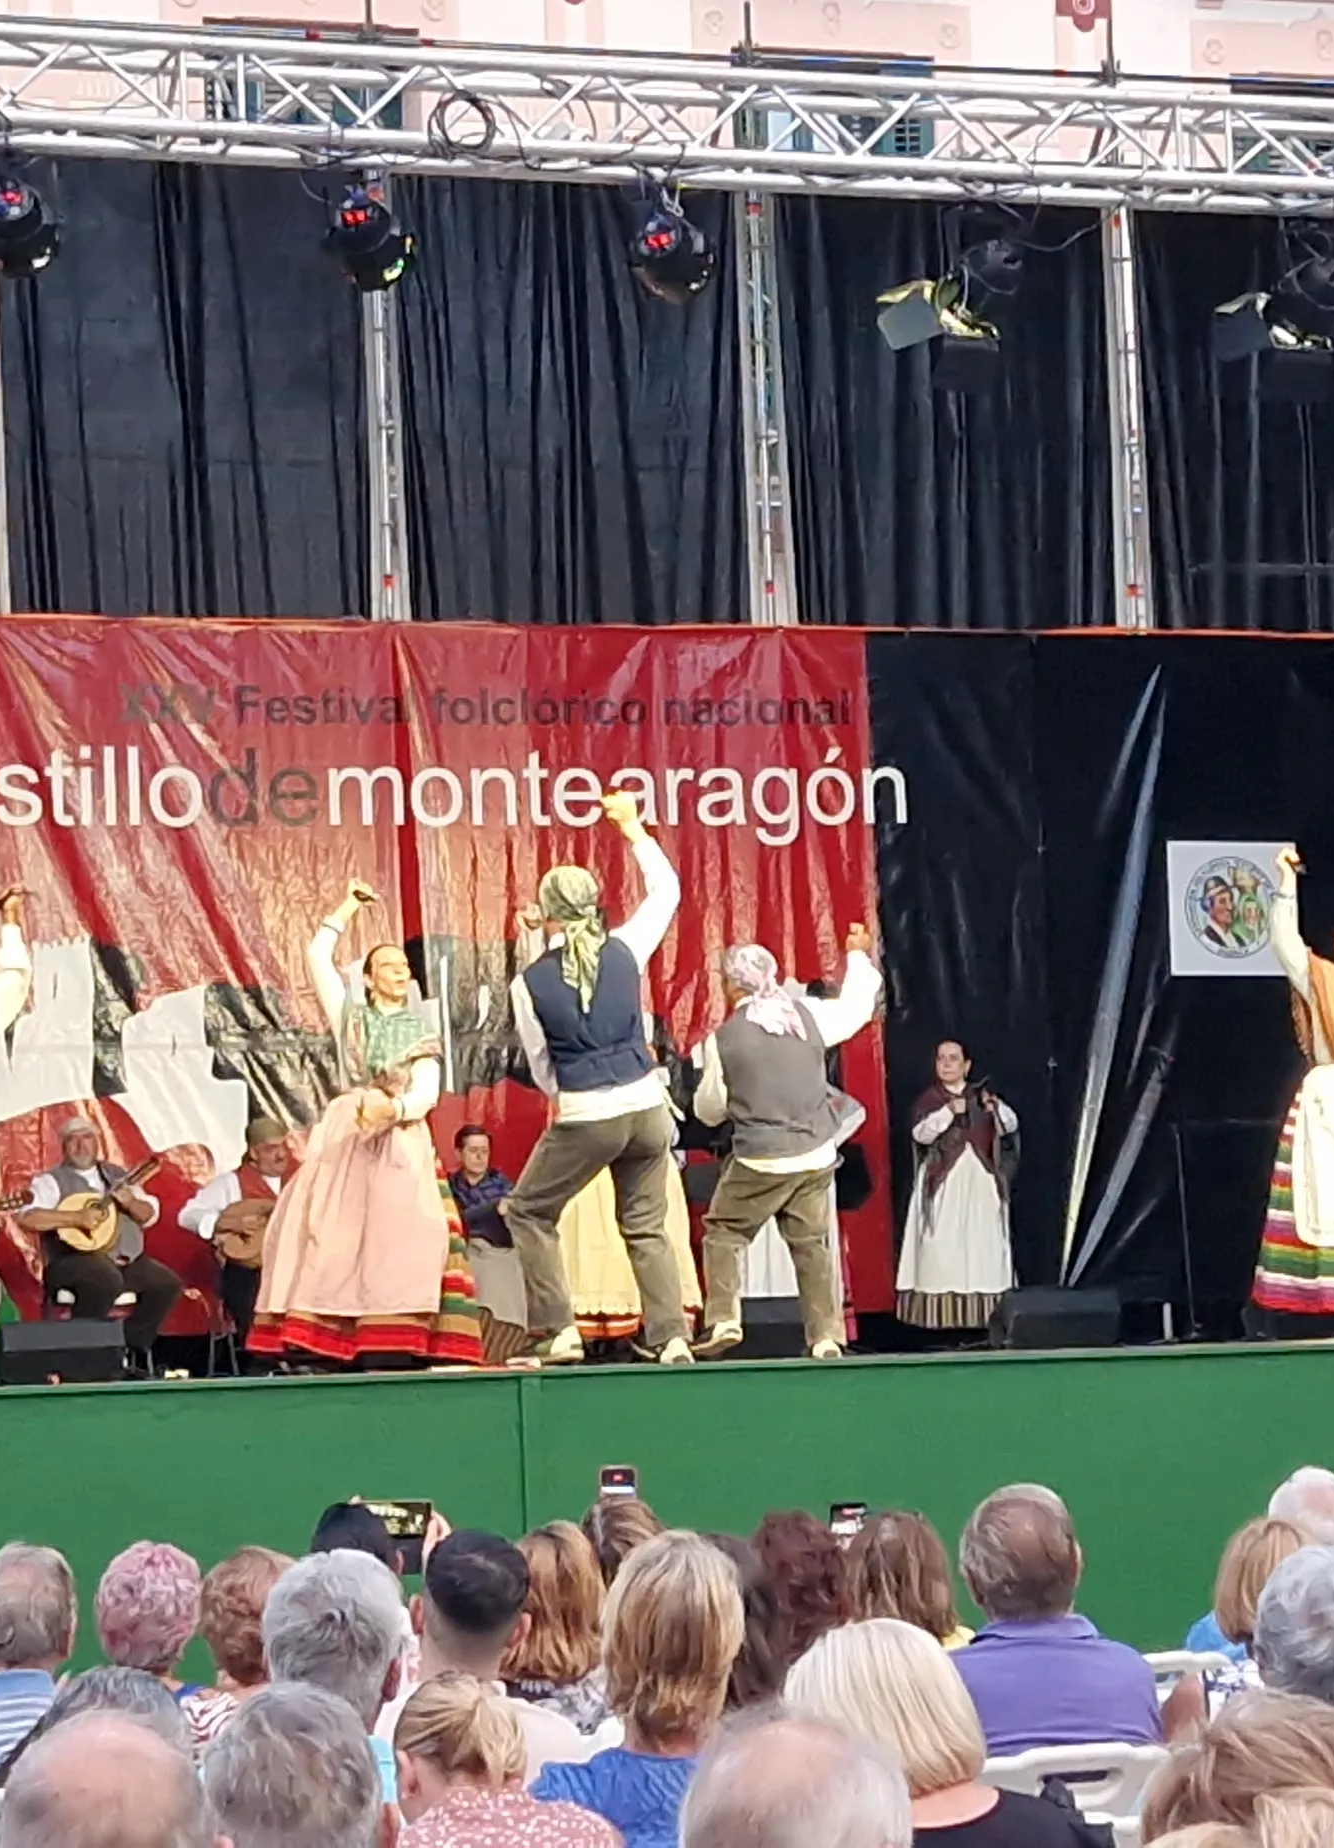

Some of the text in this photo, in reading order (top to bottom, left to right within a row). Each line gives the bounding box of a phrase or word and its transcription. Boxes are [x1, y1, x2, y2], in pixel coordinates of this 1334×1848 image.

[233, 684, 412, 726] Festival
[435, 686, 647, 728] folclórico
[665, 688, 852, 728] nacional
